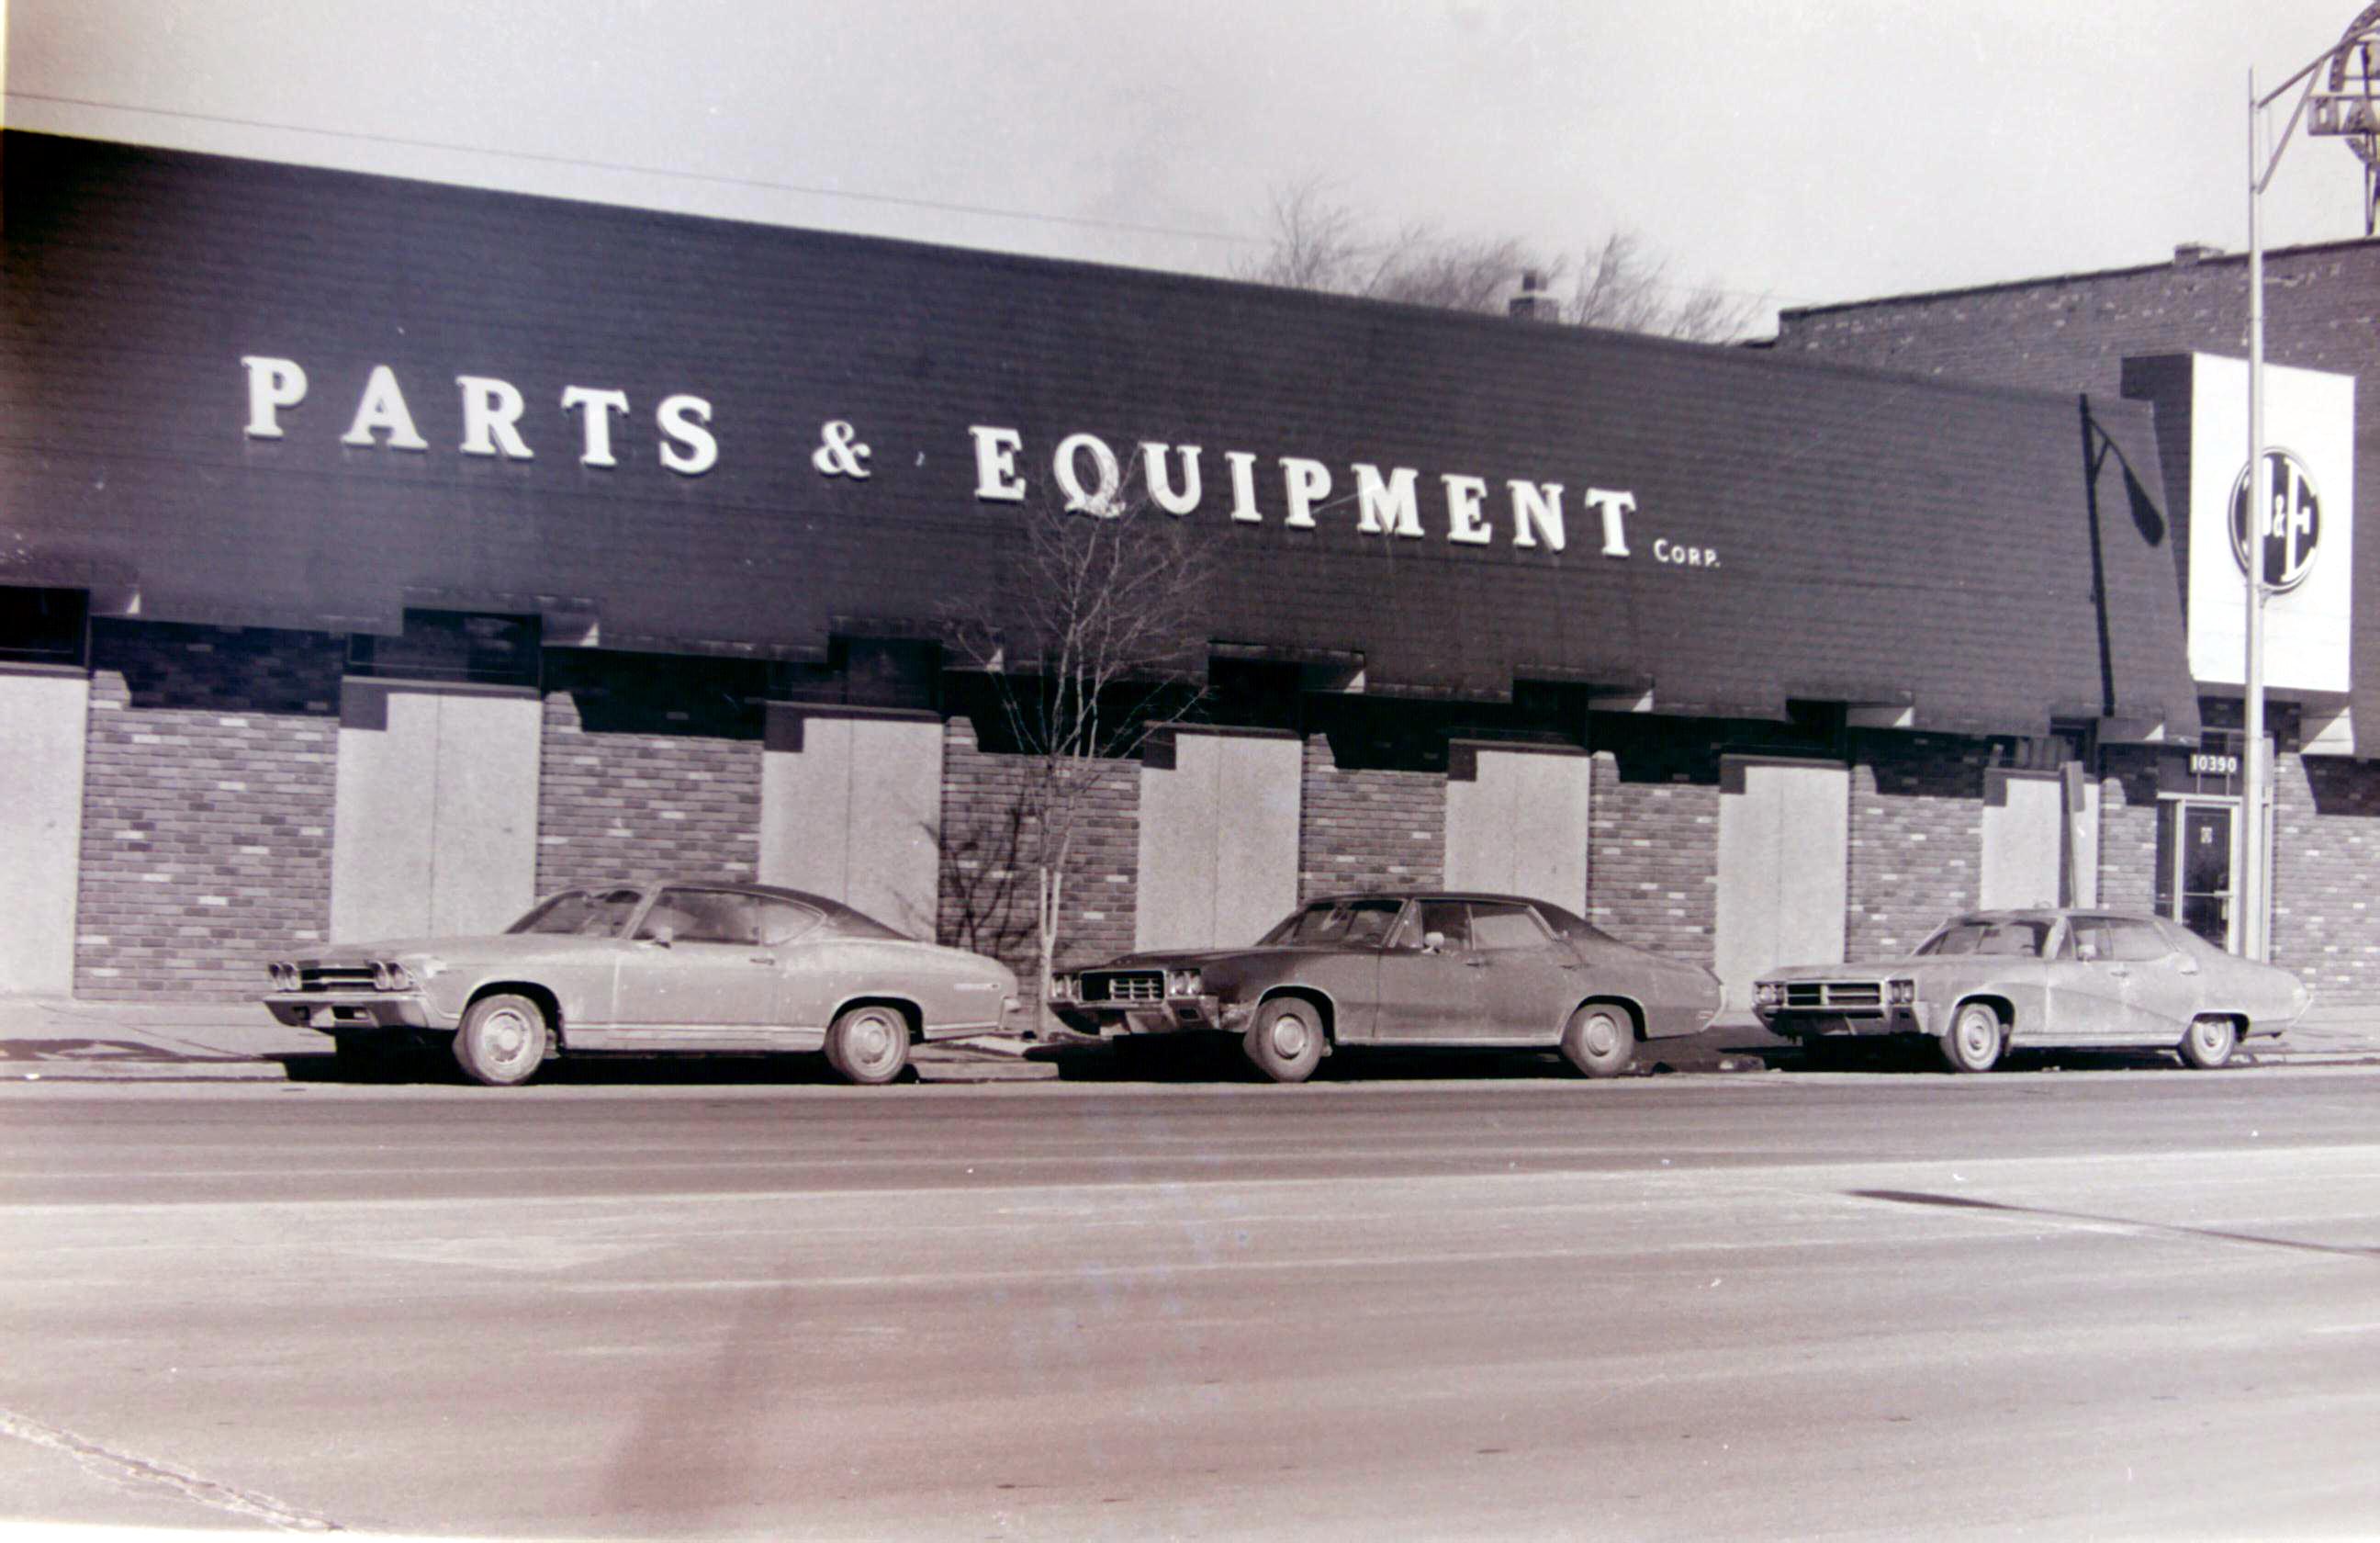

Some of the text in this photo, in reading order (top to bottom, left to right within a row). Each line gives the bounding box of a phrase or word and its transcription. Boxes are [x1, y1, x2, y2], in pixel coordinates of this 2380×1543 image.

[241, 355, 719, 475] PARTS
[812, 419, 871, 479] &
[968, 424, 1637, 558] EQUIPMENT
[2191, 753, 2238, 773] 10390
